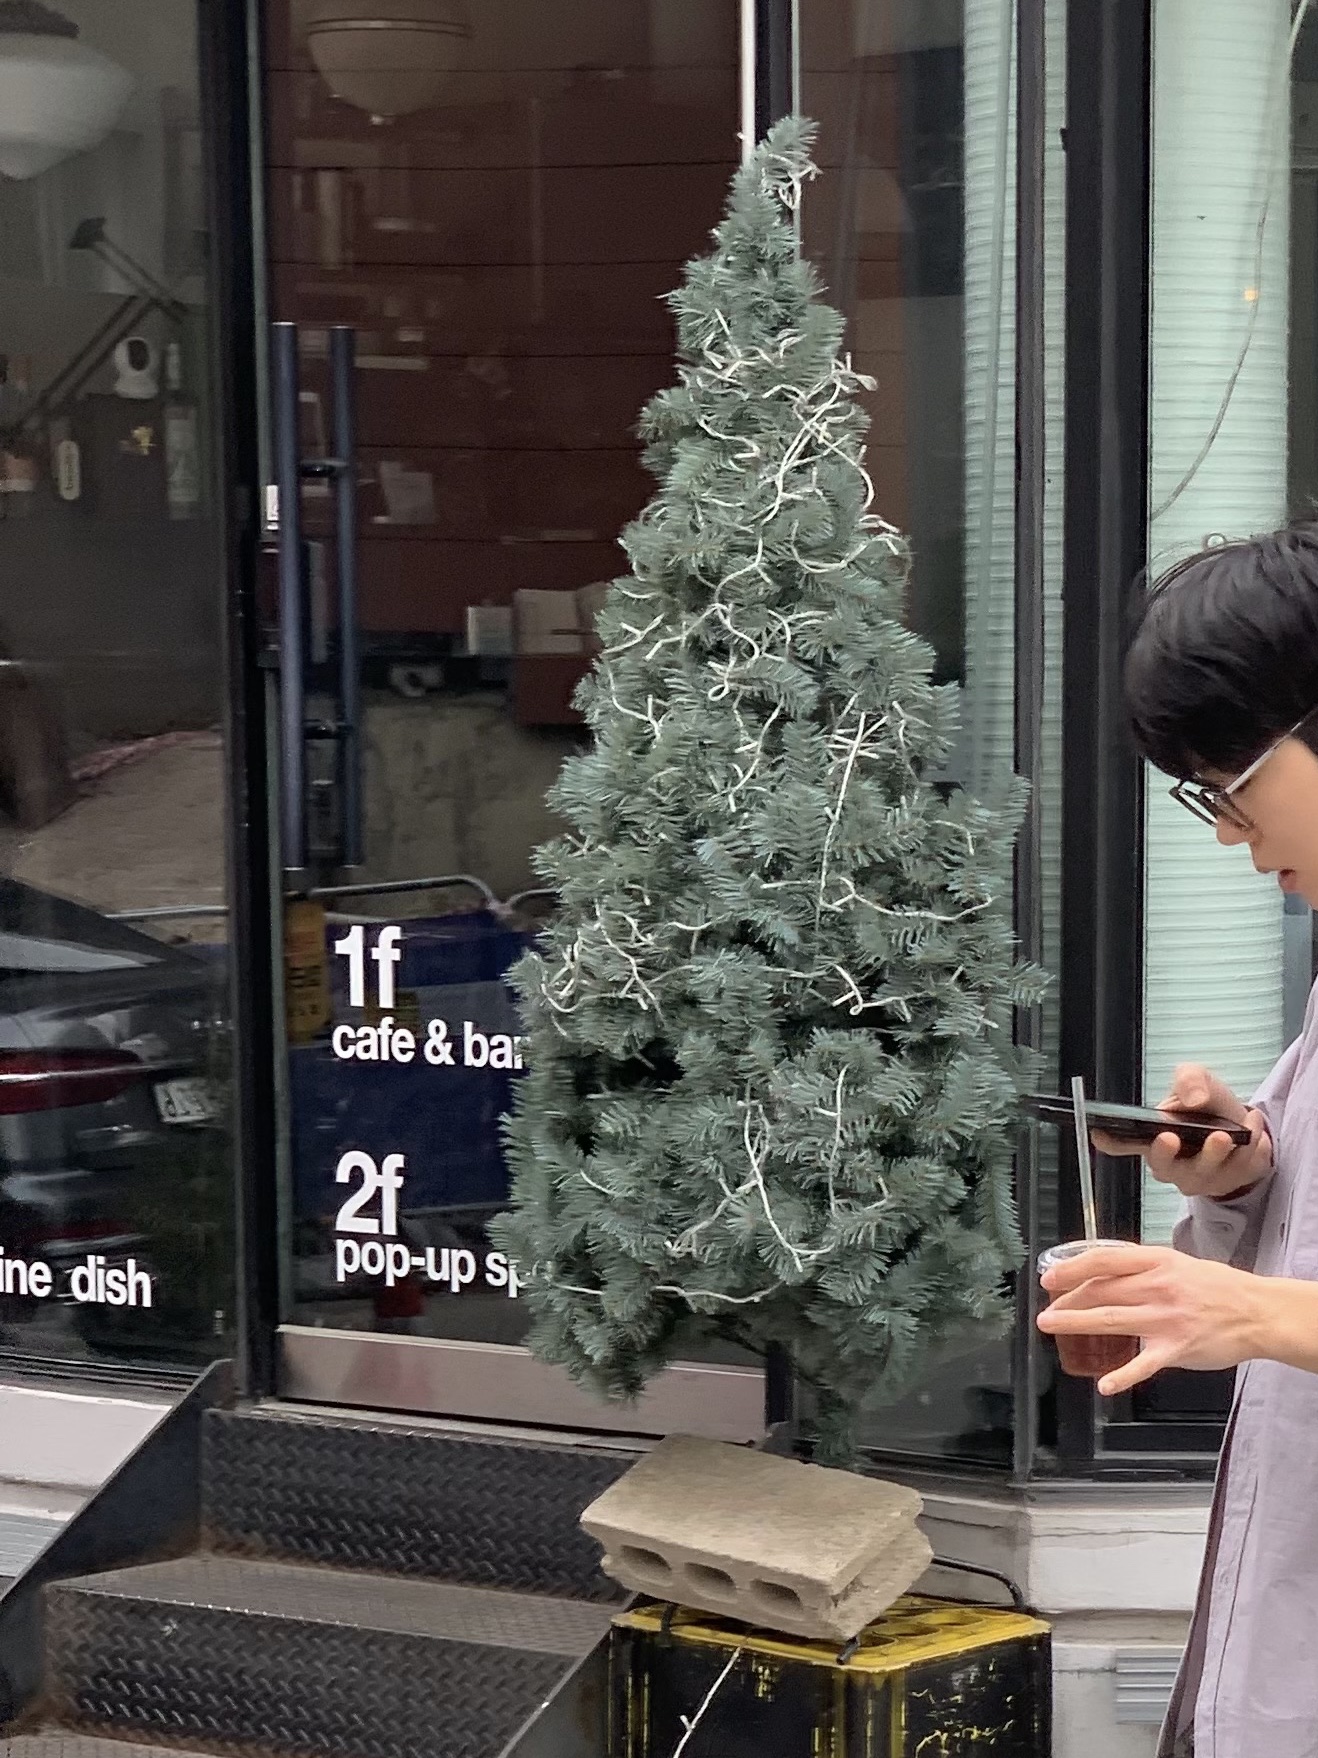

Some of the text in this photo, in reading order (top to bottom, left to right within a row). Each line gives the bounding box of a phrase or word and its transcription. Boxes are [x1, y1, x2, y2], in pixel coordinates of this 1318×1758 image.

[335, 926, 401, 1009] 1f
[332, 1016, 416, 1063] cafe
[424, 1018, 456, 1066] &
[335, 1150, 405, 1236] 2f
[70, 1254, 152, 1308] dish
[335, 1238, 477, 1293] pop-up
